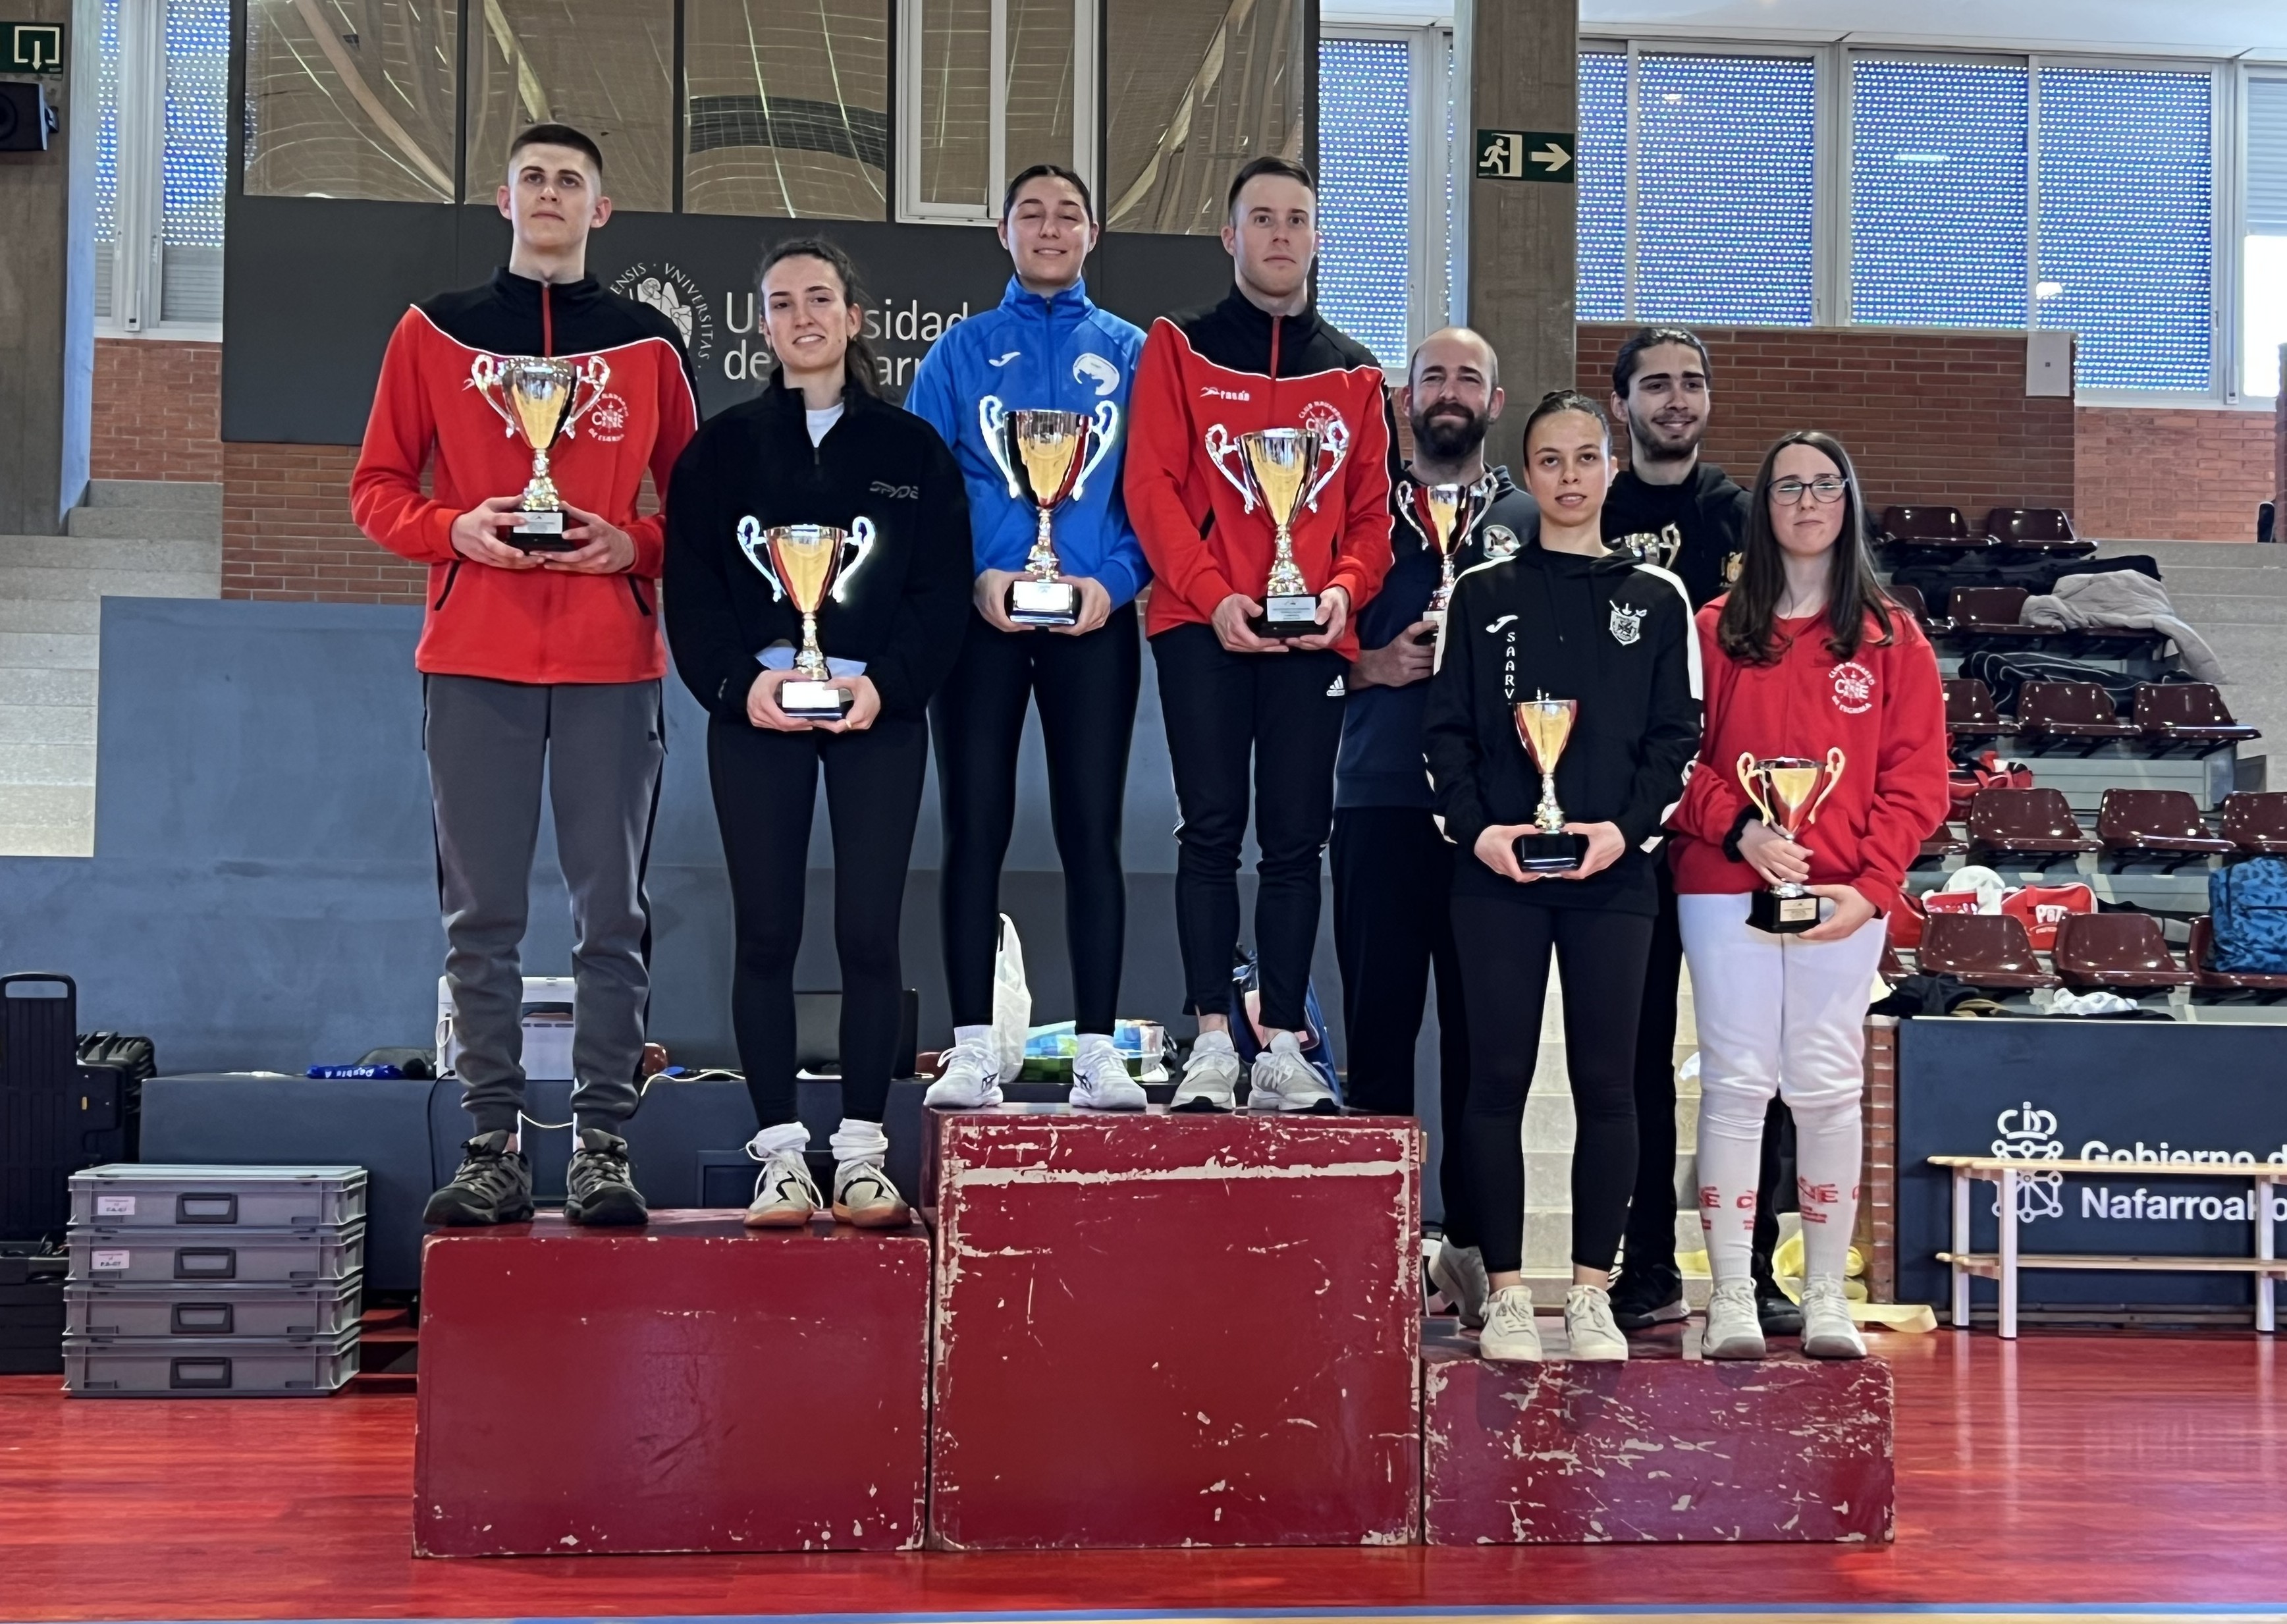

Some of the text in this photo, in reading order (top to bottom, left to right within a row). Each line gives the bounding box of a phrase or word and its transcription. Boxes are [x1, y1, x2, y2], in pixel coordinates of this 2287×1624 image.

[610, 263, 647, 295] ENSIS
[726, 292, 968, 341] Usidad
[724, 339, 770, 381] de
[2081, 1140, 2287, 1164] Gobierno d
